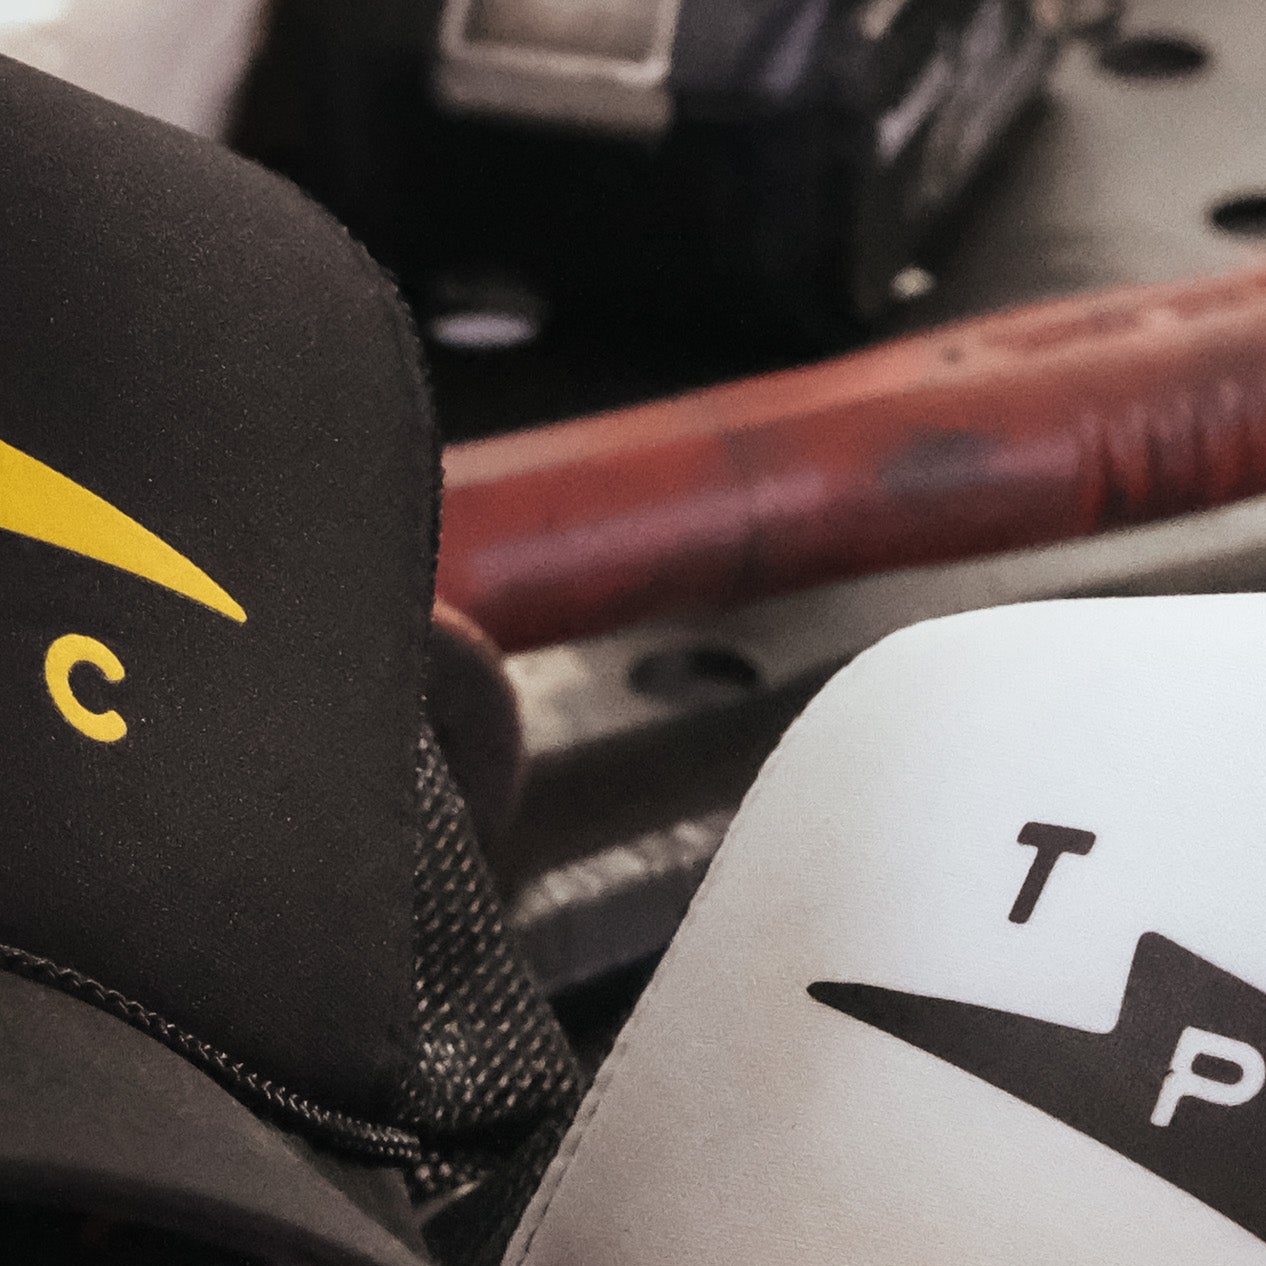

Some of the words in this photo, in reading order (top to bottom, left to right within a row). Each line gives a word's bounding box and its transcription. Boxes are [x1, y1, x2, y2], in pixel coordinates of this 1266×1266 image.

[44, 633, 127, 743] C
[1008, 822, 1097, 925] T
[1149, 1025, 1266, 1127] P
